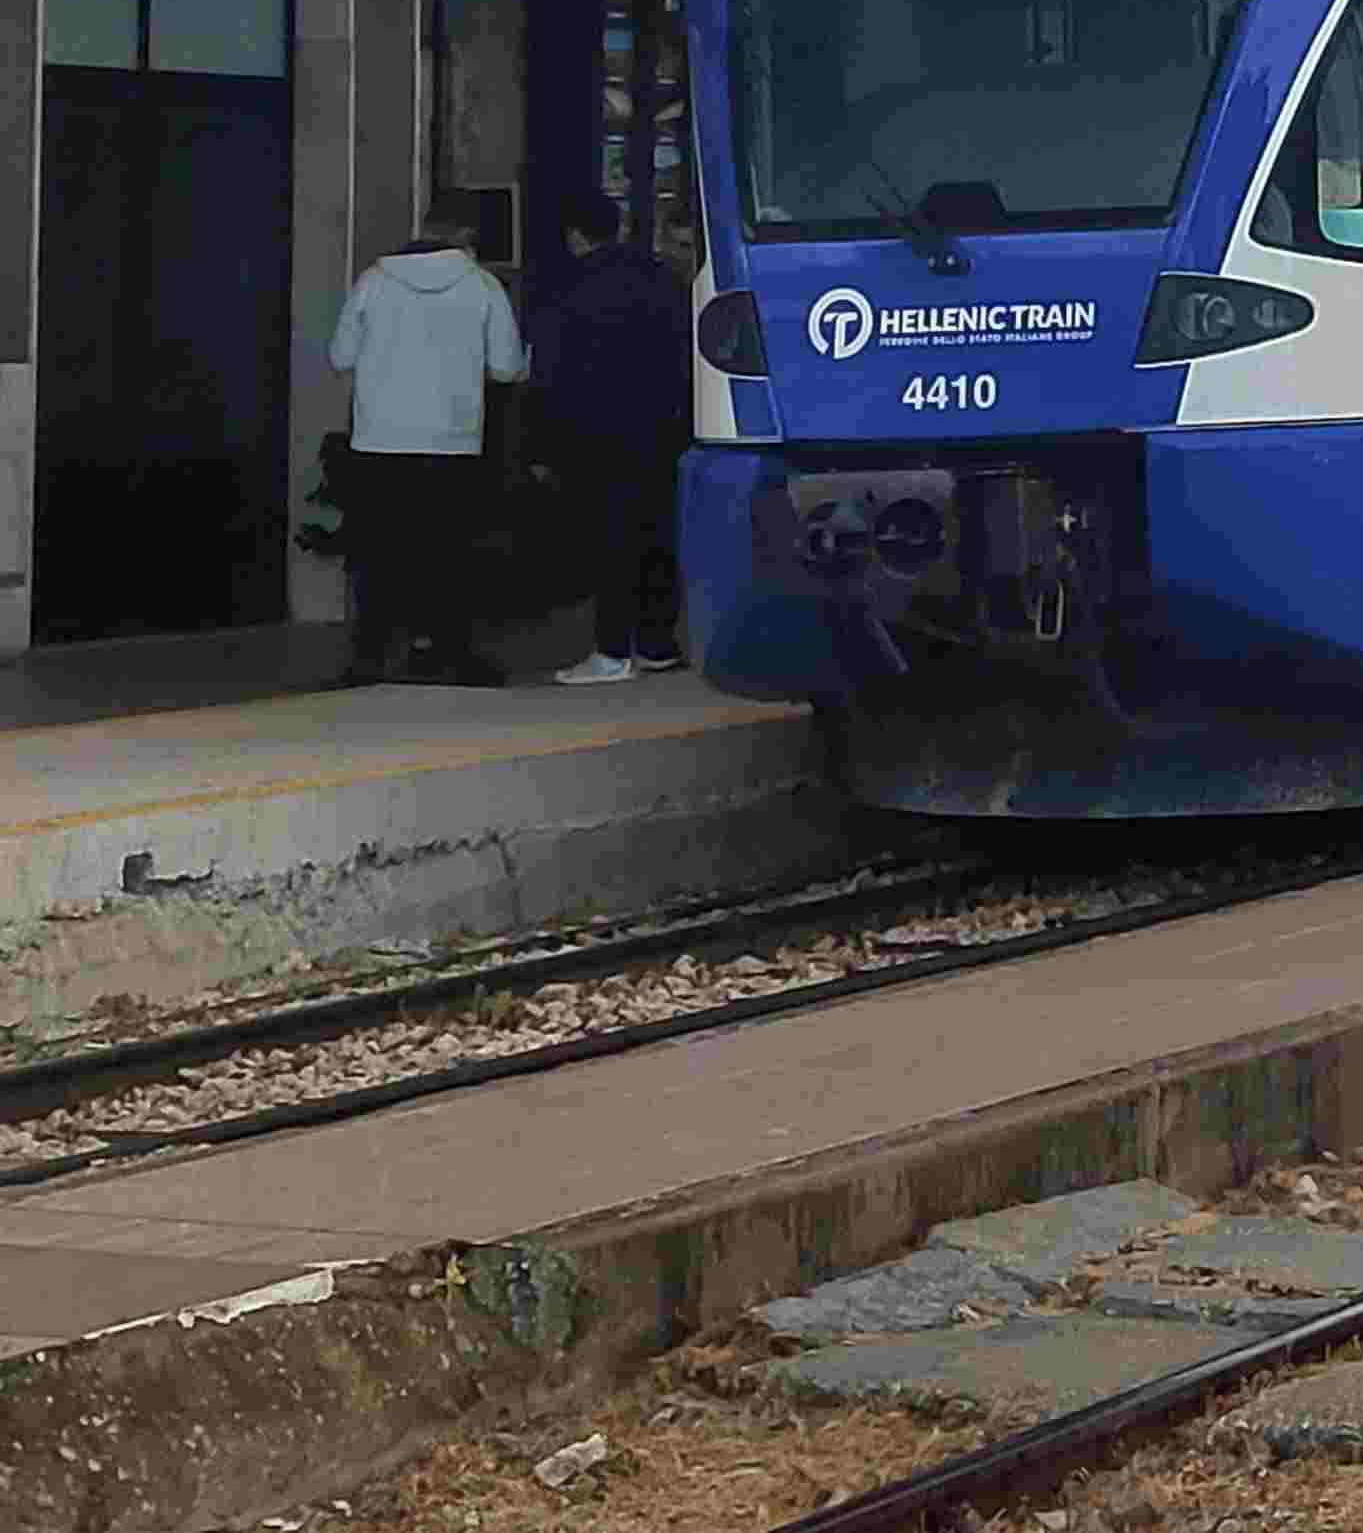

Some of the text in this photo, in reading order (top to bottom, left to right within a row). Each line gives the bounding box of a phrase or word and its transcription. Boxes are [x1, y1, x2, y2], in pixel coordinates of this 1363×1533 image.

[879, 302, 1096, 335] HELLENIC TRAIN
[902, 374, 997, 410] 4410
